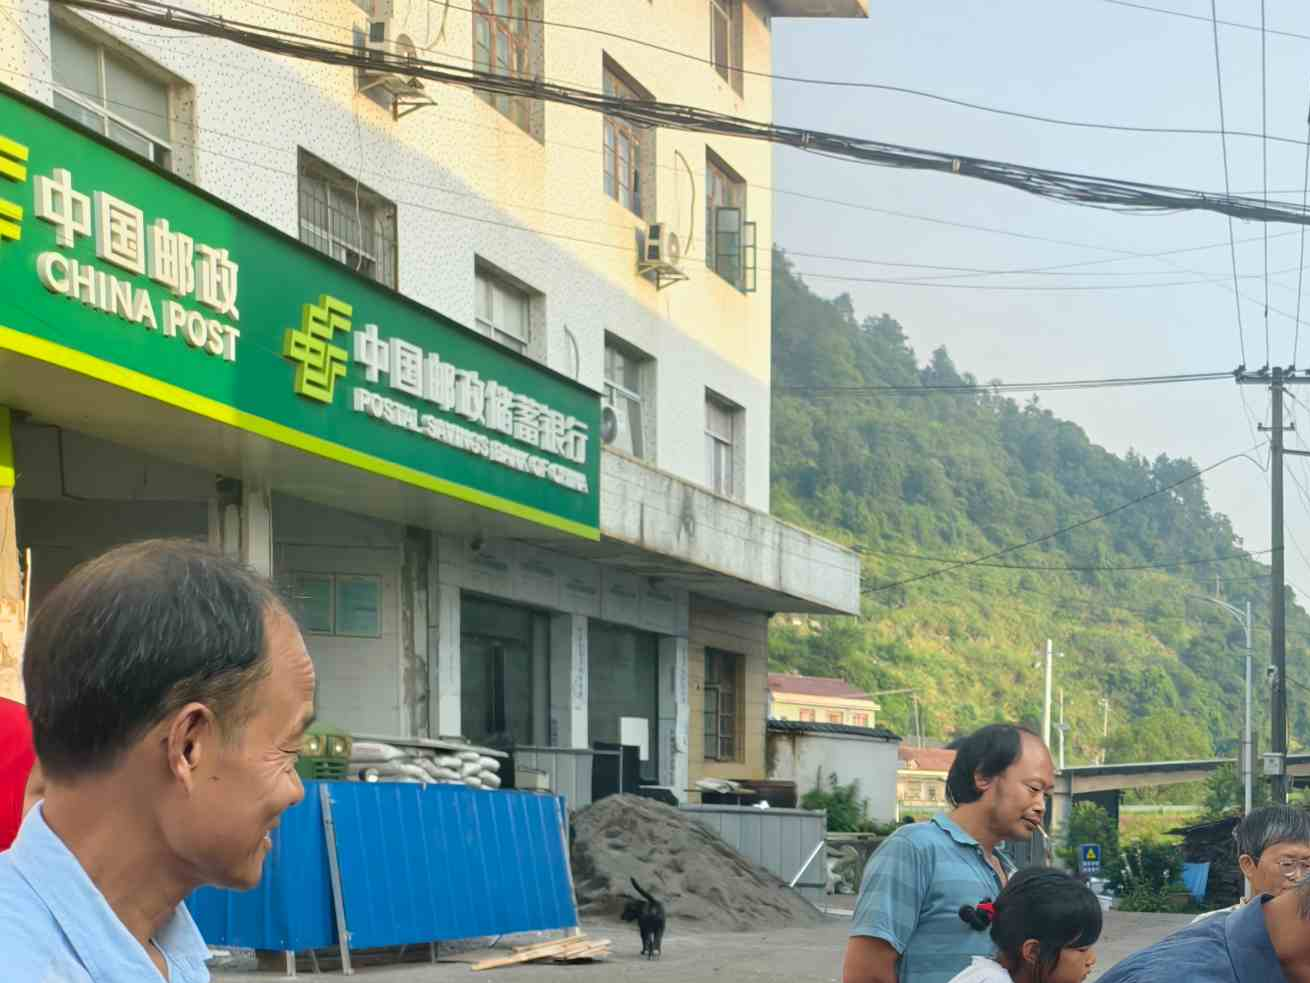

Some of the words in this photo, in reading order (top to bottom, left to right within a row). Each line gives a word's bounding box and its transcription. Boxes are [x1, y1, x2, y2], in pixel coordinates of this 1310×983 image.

[33, 168, 239, 320] 中国邮政
[37, 252, 157, 329] CHINA
[162, 300, 240, 361] POST
[353, 324, 588, 463] 中国邮政储蓄银行
[353, 388, 423, 434] POSTAL
[421, 414, 489, 458] SAVINGS
[489, 441, 529, 473] BANK
[528, 456, 550, 477] OF
